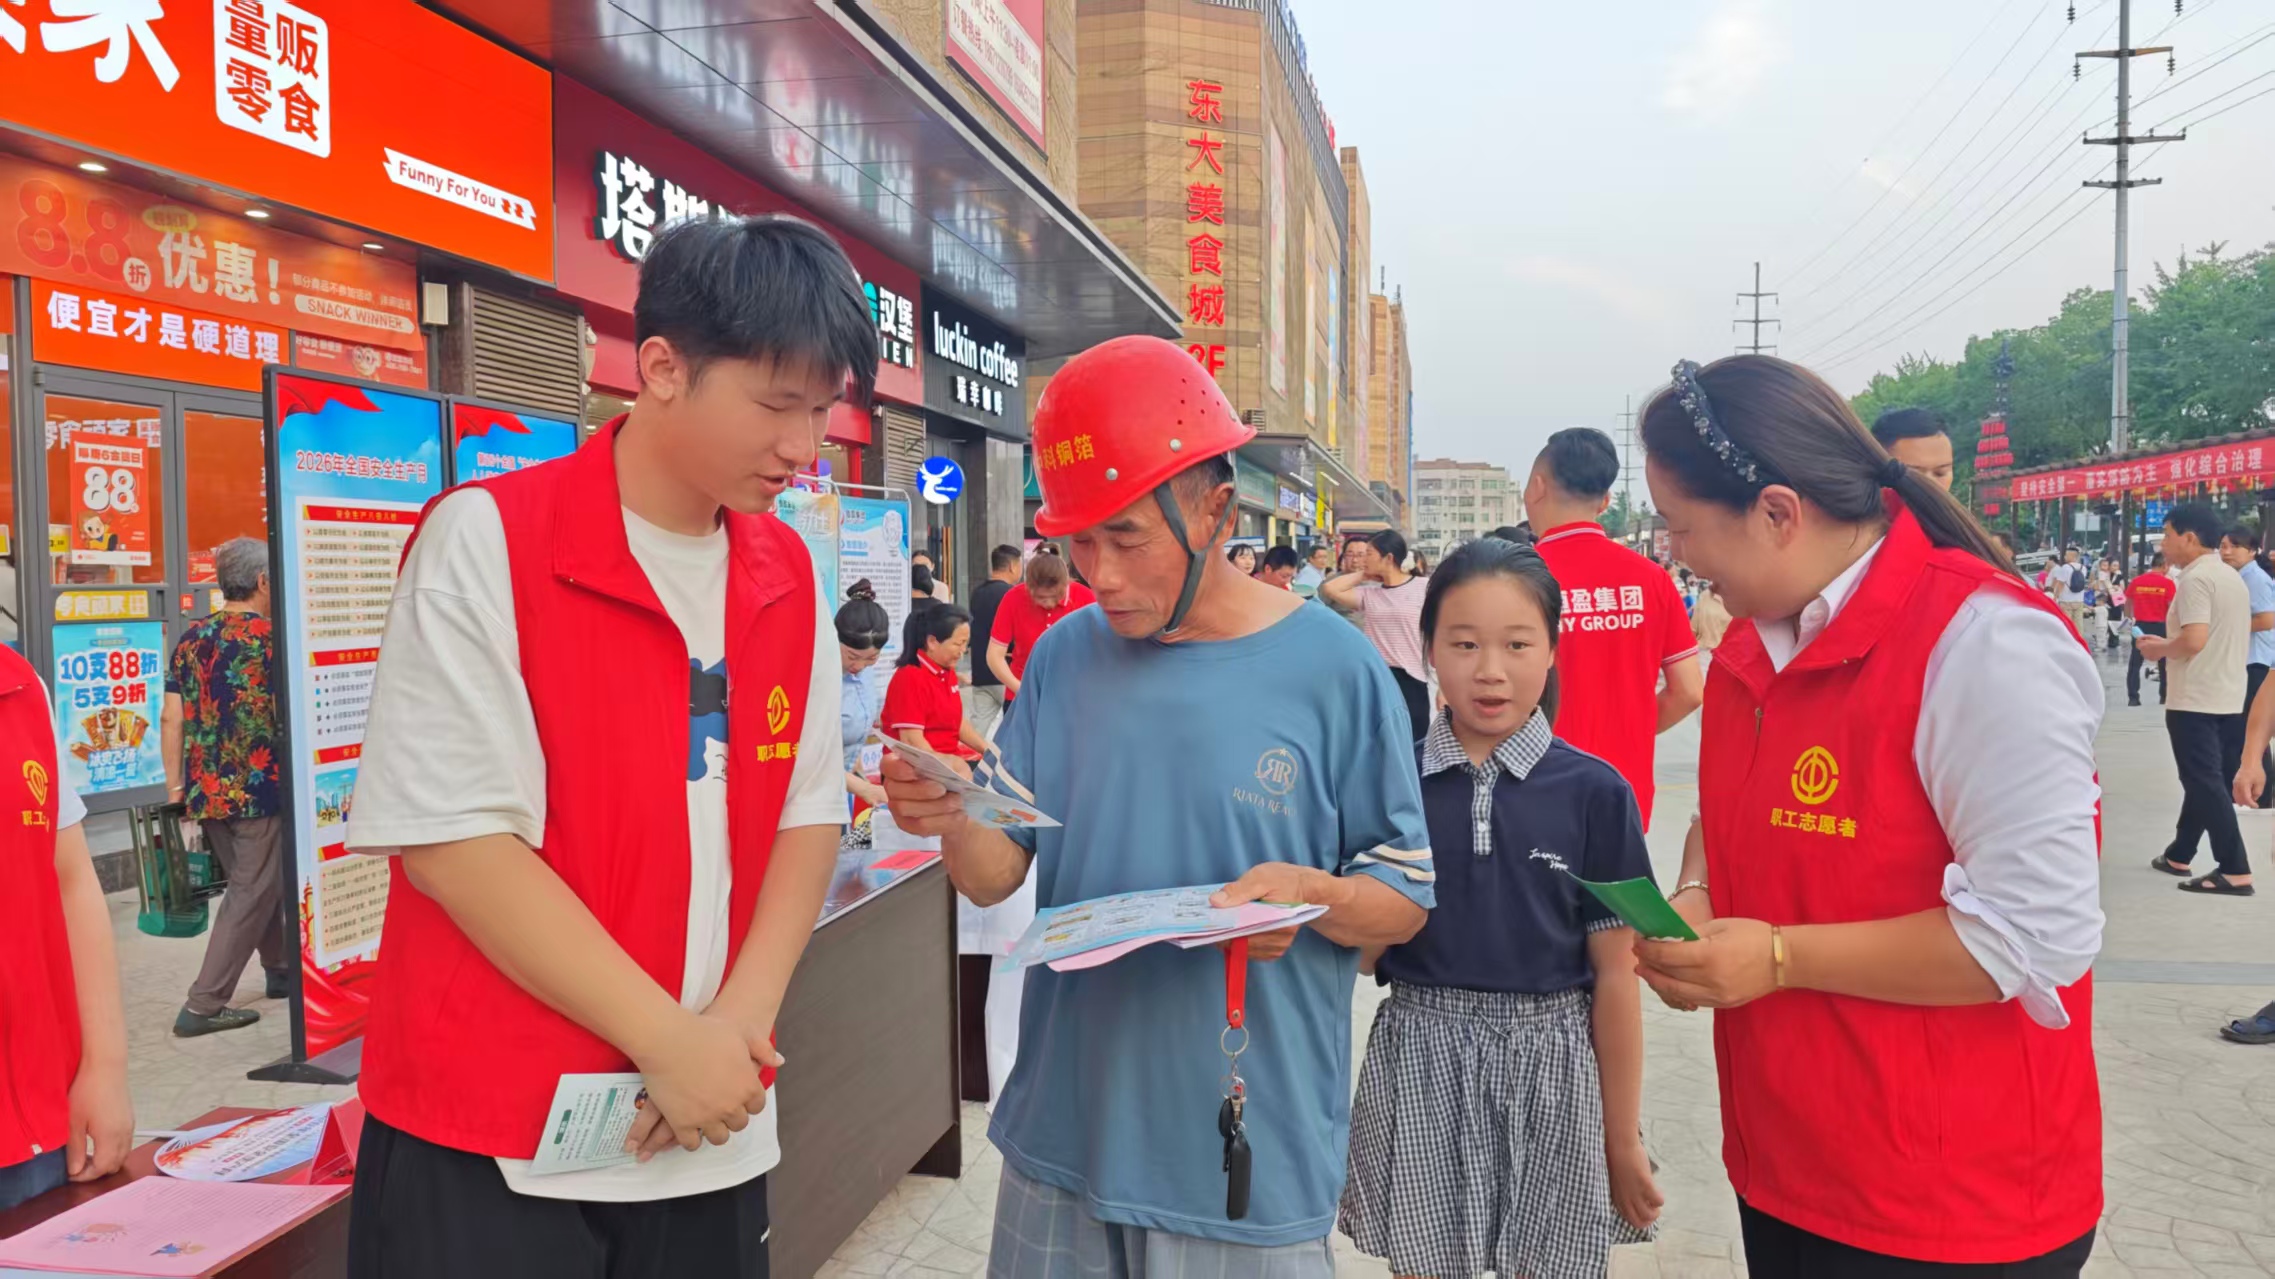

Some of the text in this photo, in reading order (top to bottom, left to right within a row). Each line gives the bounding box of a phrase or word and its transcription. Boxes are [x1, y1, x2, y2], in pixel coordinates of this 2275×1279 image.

[225, 0, 319, 80] 量贩
[226, 57, 320, 142] 零食
[399, 160, 496, 208] Funny For You
[1187, 80, 1225, 325] 东大美食城
[47, 290, 280, 364] 便宜才是硬道理
[307, 298, 404, 330] SNACK WINNER
[880, 286, 913, 343] 汉堡
[934, 311, 1018, 388] luckin coffee
[296, 450, 428, 484] 2026年全国安全生产月
[2170, 447, 2263, 480] 强化综合治理
[83, 466, 136, 514] 88
[1581, 613, 1645, 632] GROUP
[60, 651, 158, 681] 10支88折
[75, 683, 147, 709] 5支9折
[1770, 807, 1857, 838] 职工志愿者
